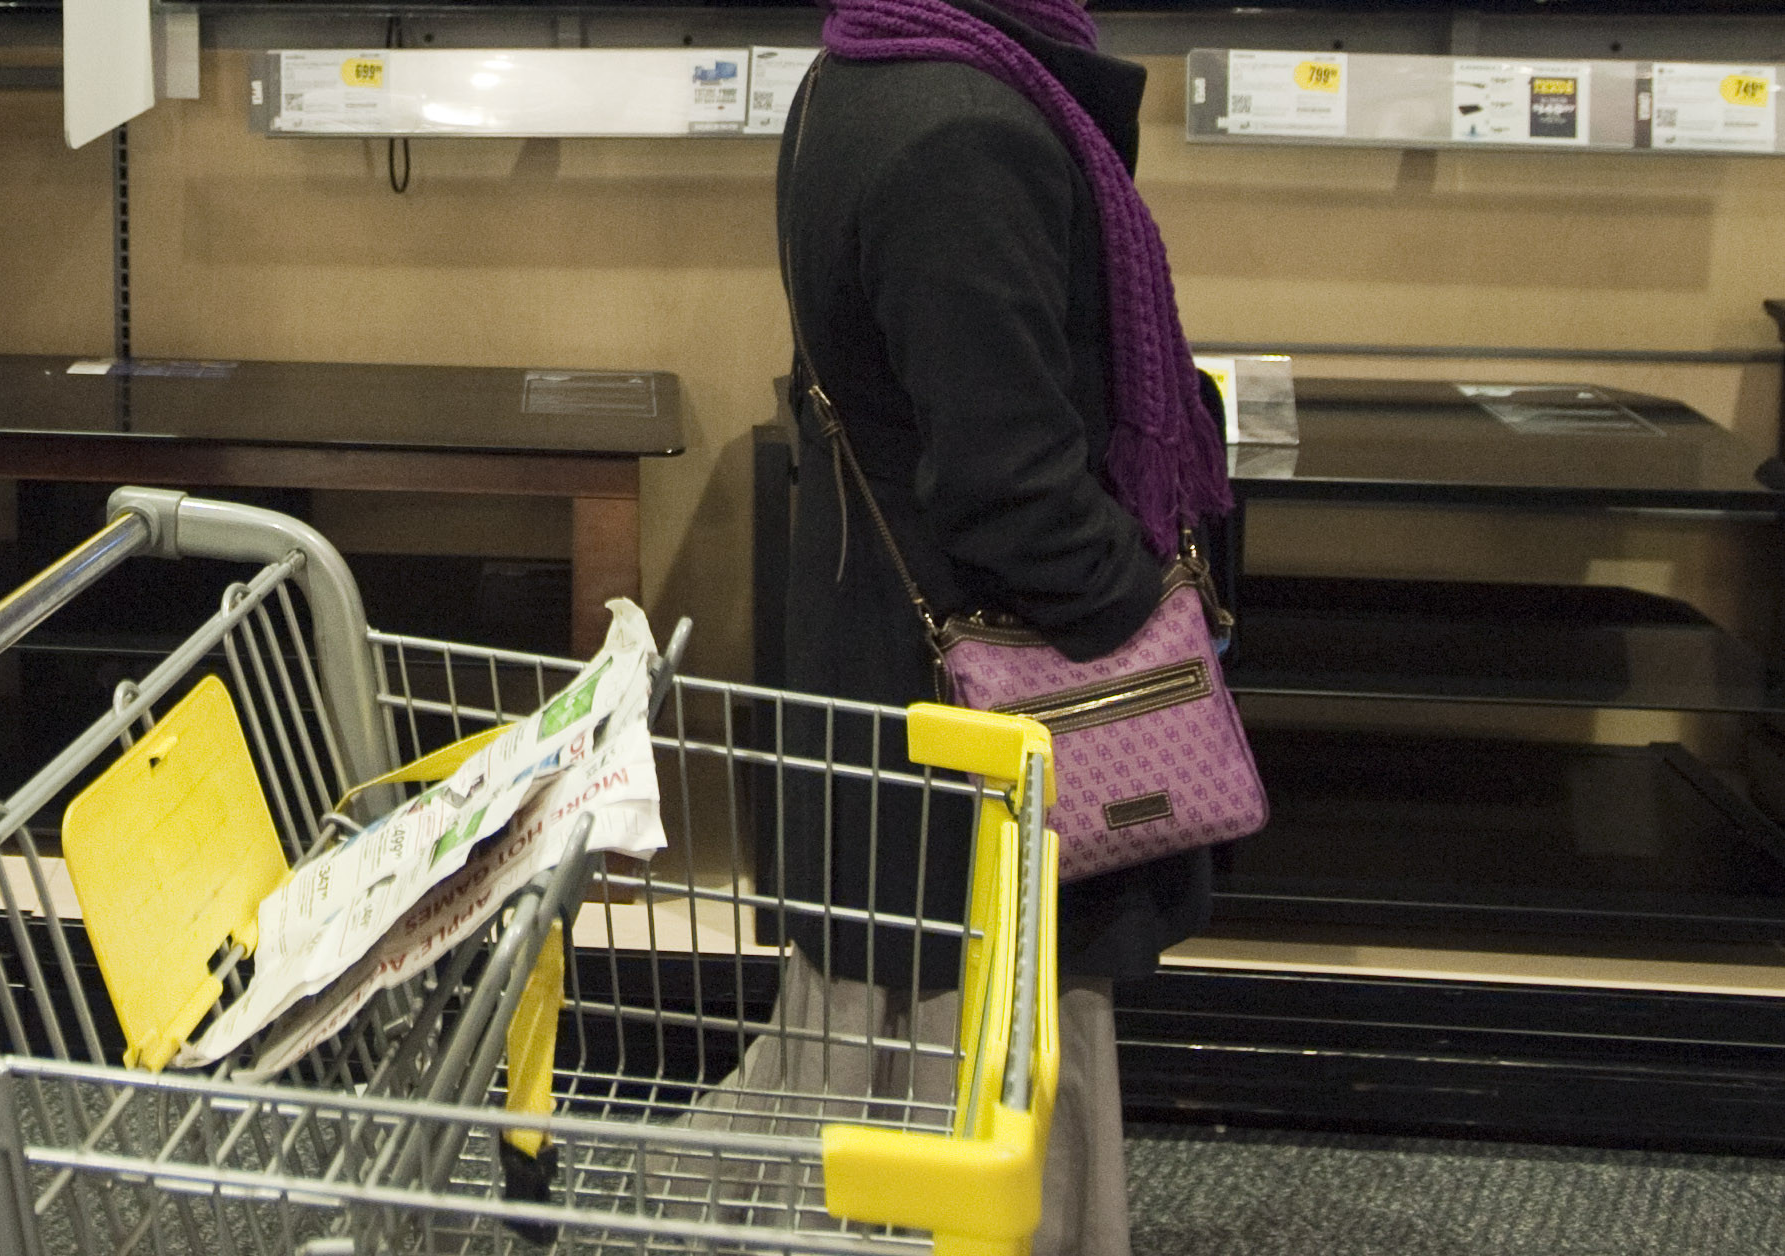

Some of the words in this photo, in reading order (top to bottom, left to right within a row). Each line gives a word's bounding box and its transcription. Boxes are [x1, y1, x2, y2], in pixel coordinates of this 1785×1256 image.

[550, 767, 629, 826] MORE
[499, 821, 543, 866] HOT
[404, 866, 490, 937] GAMES
